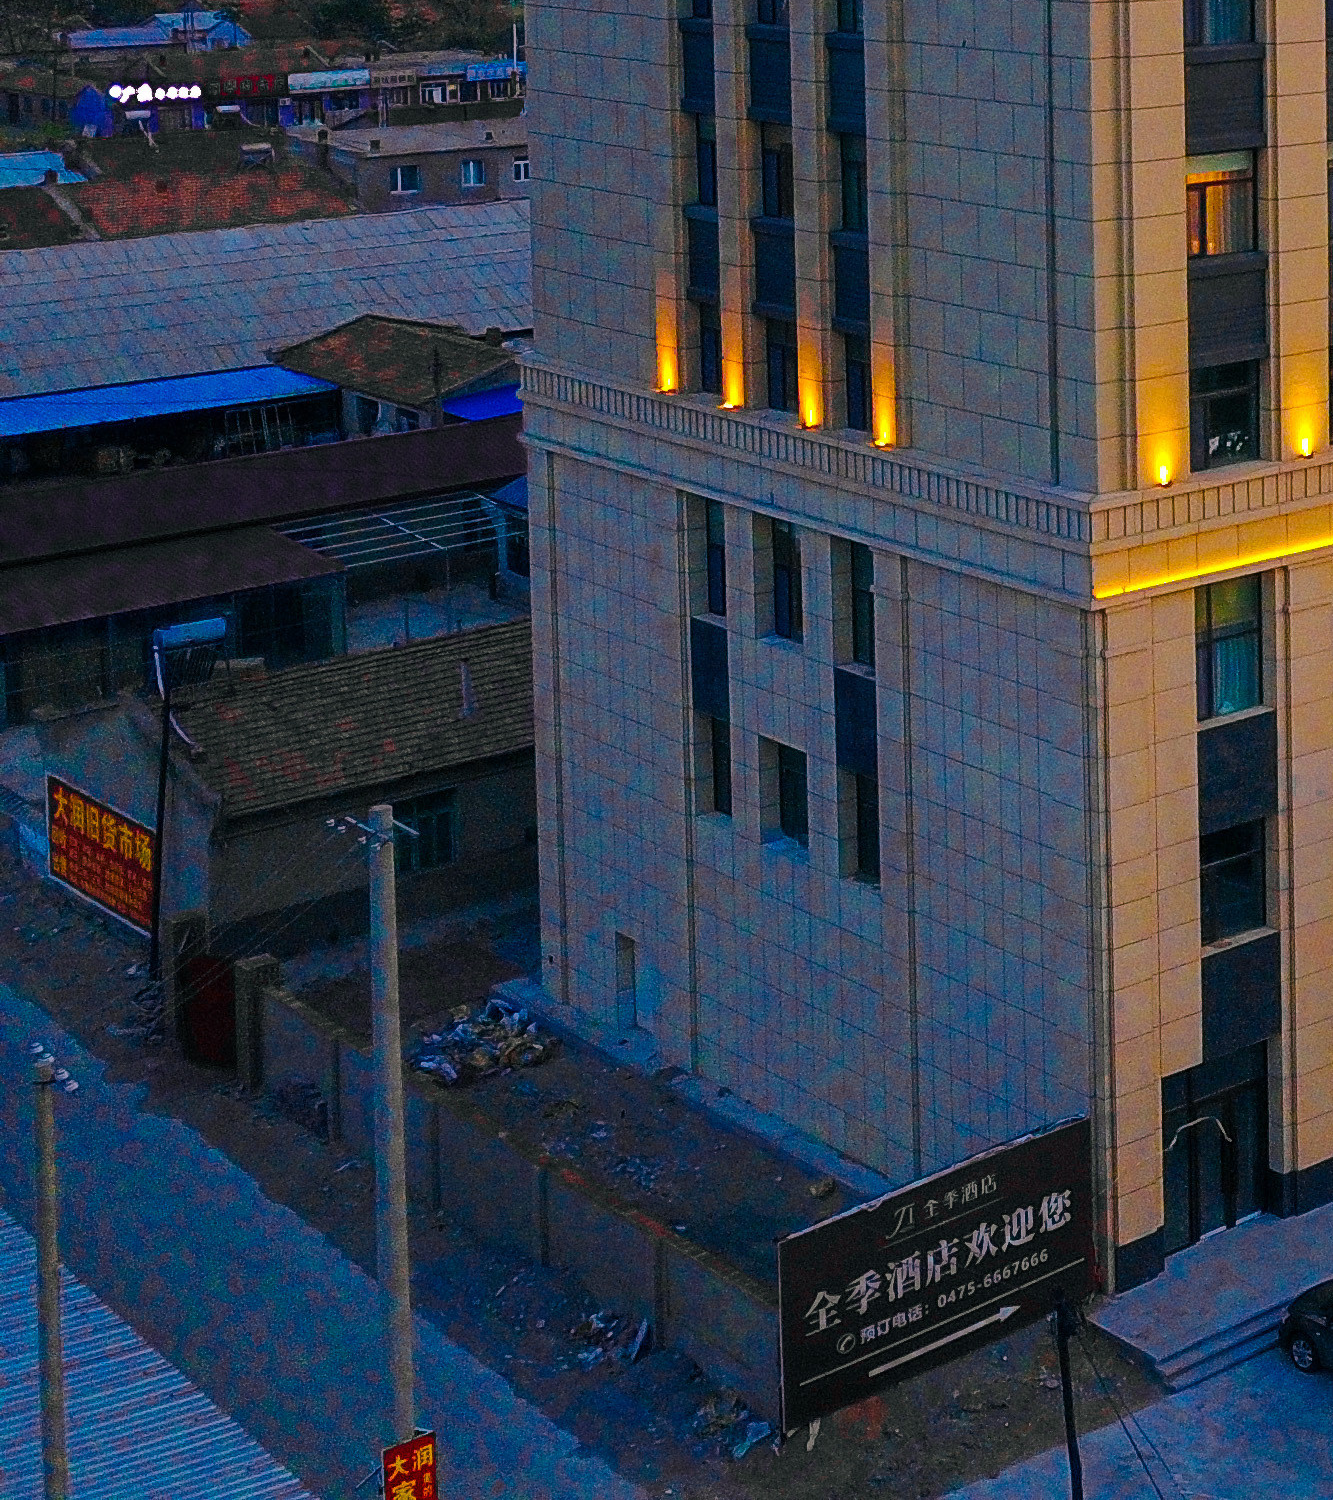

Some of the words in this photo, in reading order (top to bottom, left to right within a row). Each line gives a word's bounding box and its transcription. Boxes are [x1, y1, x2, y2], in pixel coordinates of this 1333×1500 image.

[923, 1174, 997, 1219] 全季酒店
[804, 1188, 1073, 1337] 全季酒店欢迎您
